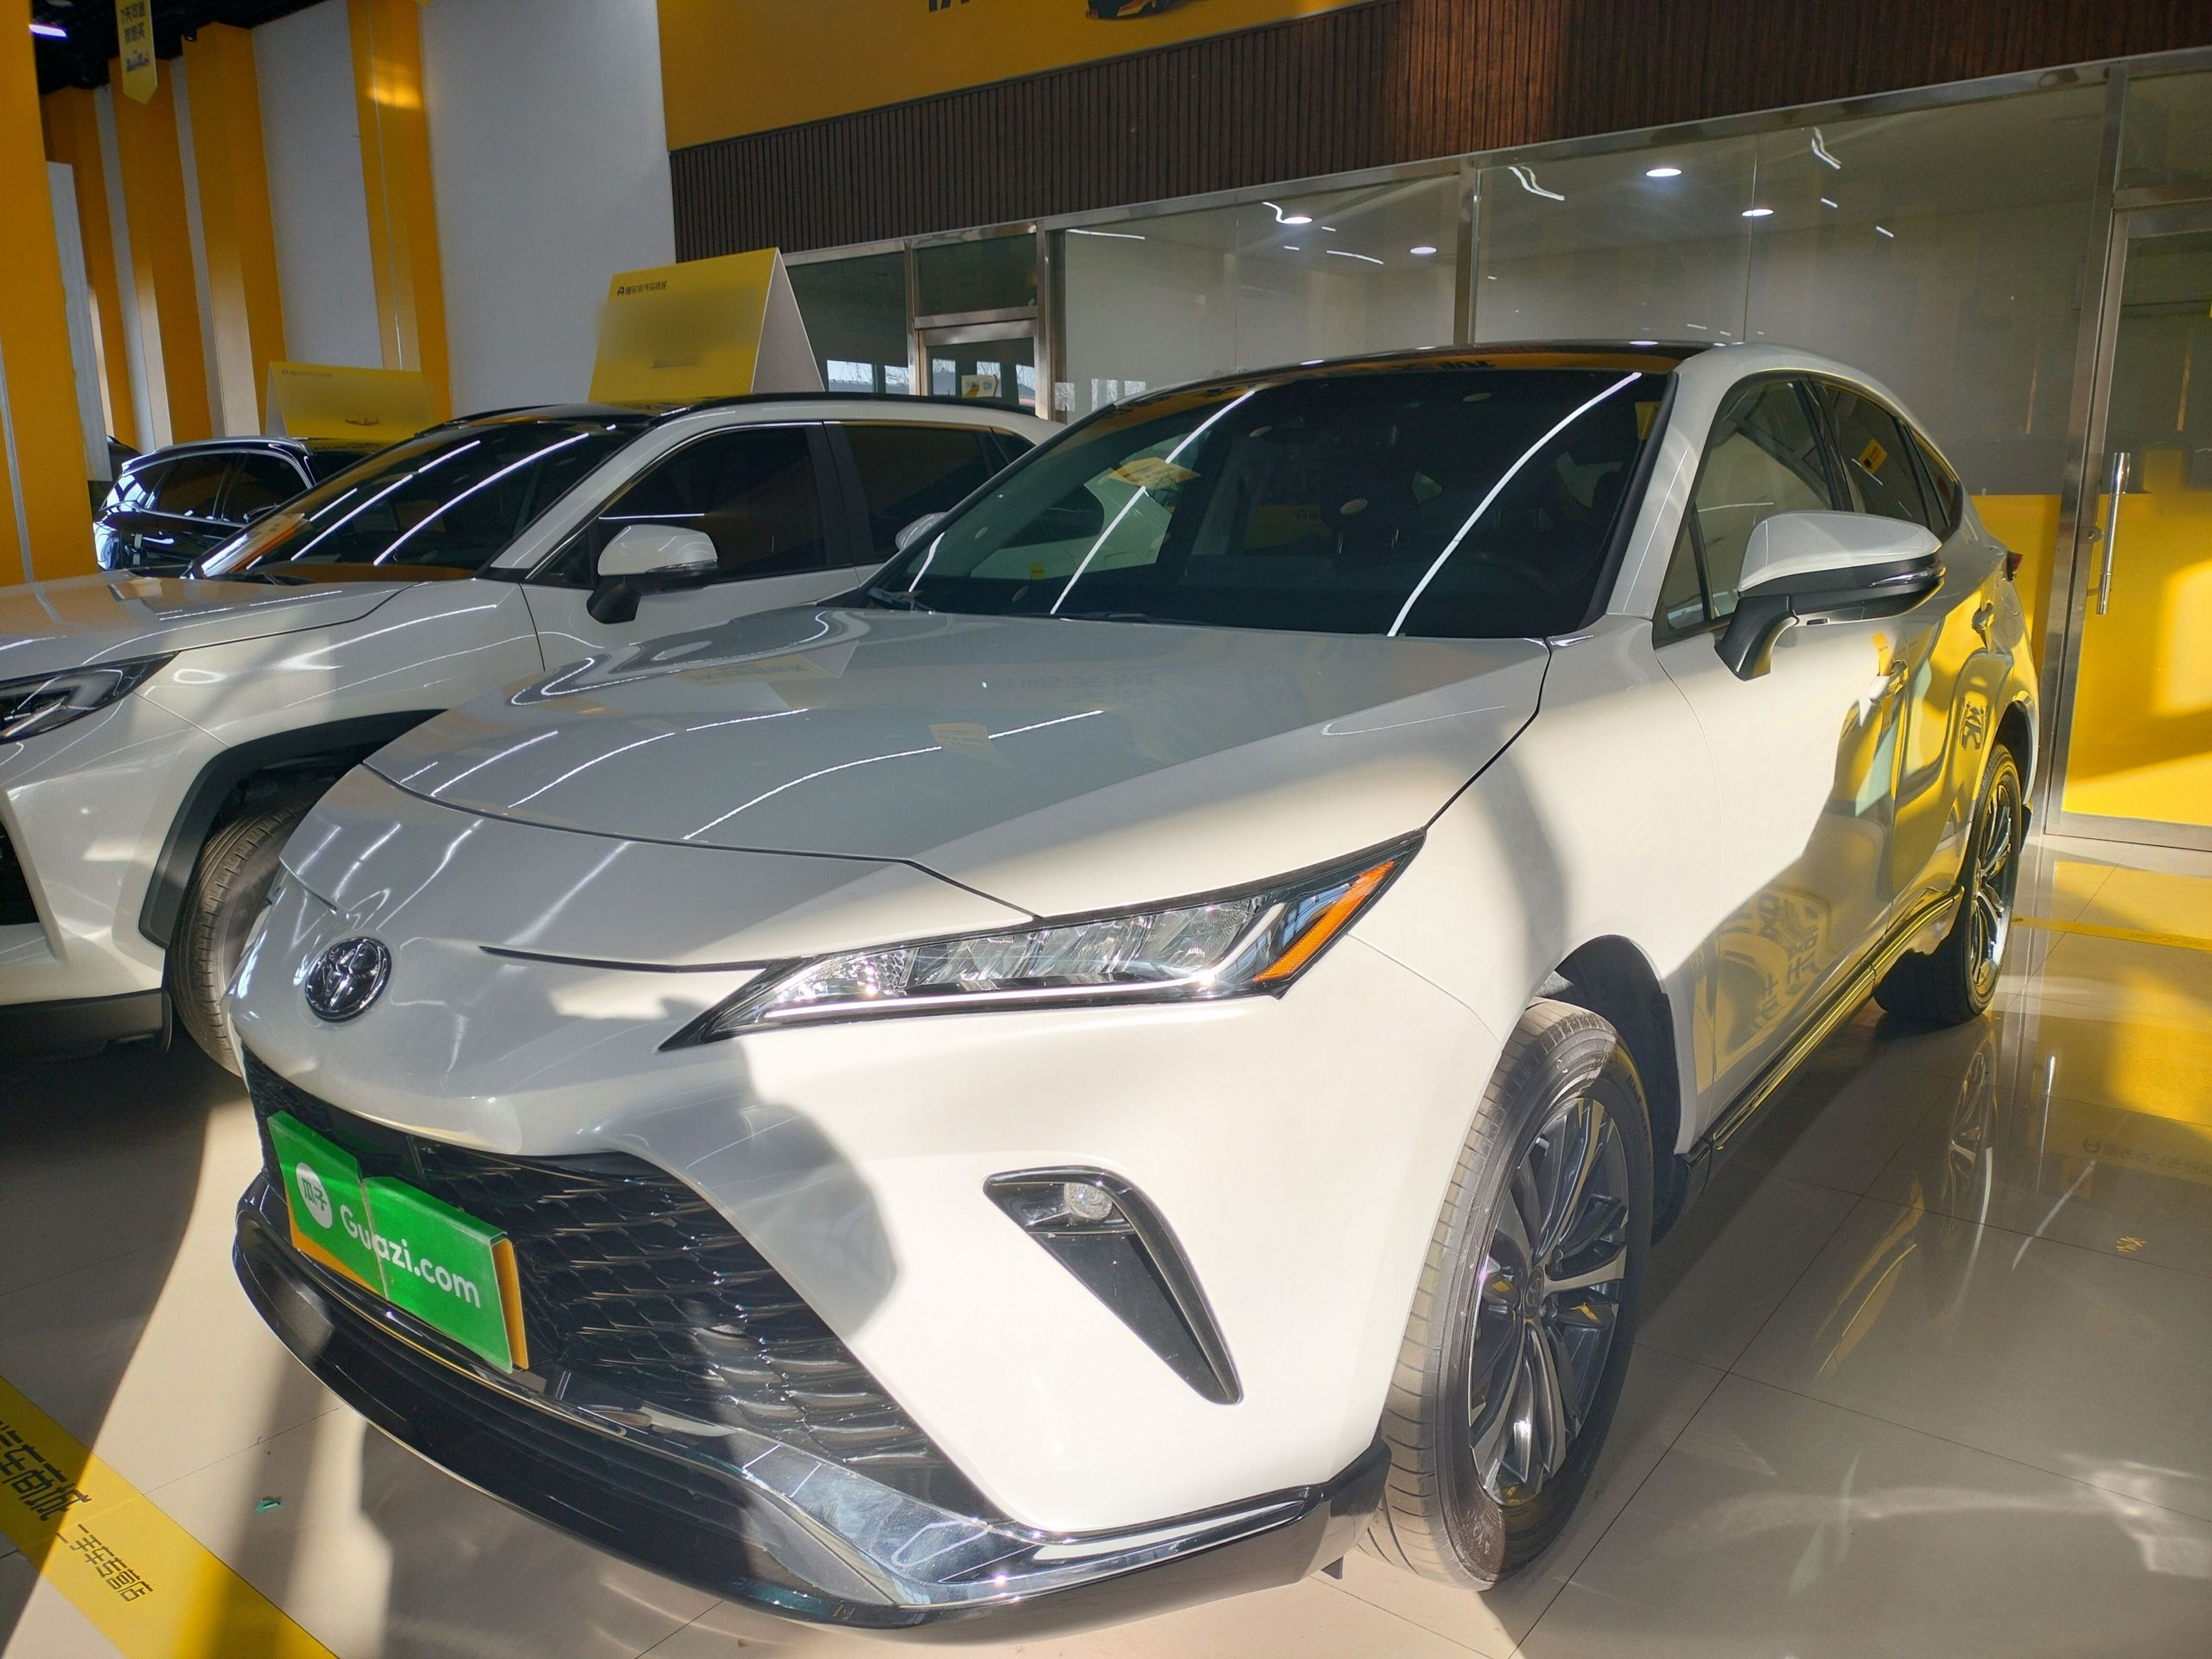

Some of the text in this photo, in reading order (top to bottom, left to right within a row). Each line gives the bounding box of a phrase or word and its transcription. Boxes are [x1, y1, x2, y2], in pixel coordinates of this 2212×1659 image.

[301, 1177, 481, 1308] 瓜子 Guazi.com
[56, 1524, 154, 1602] 二手车专营店
